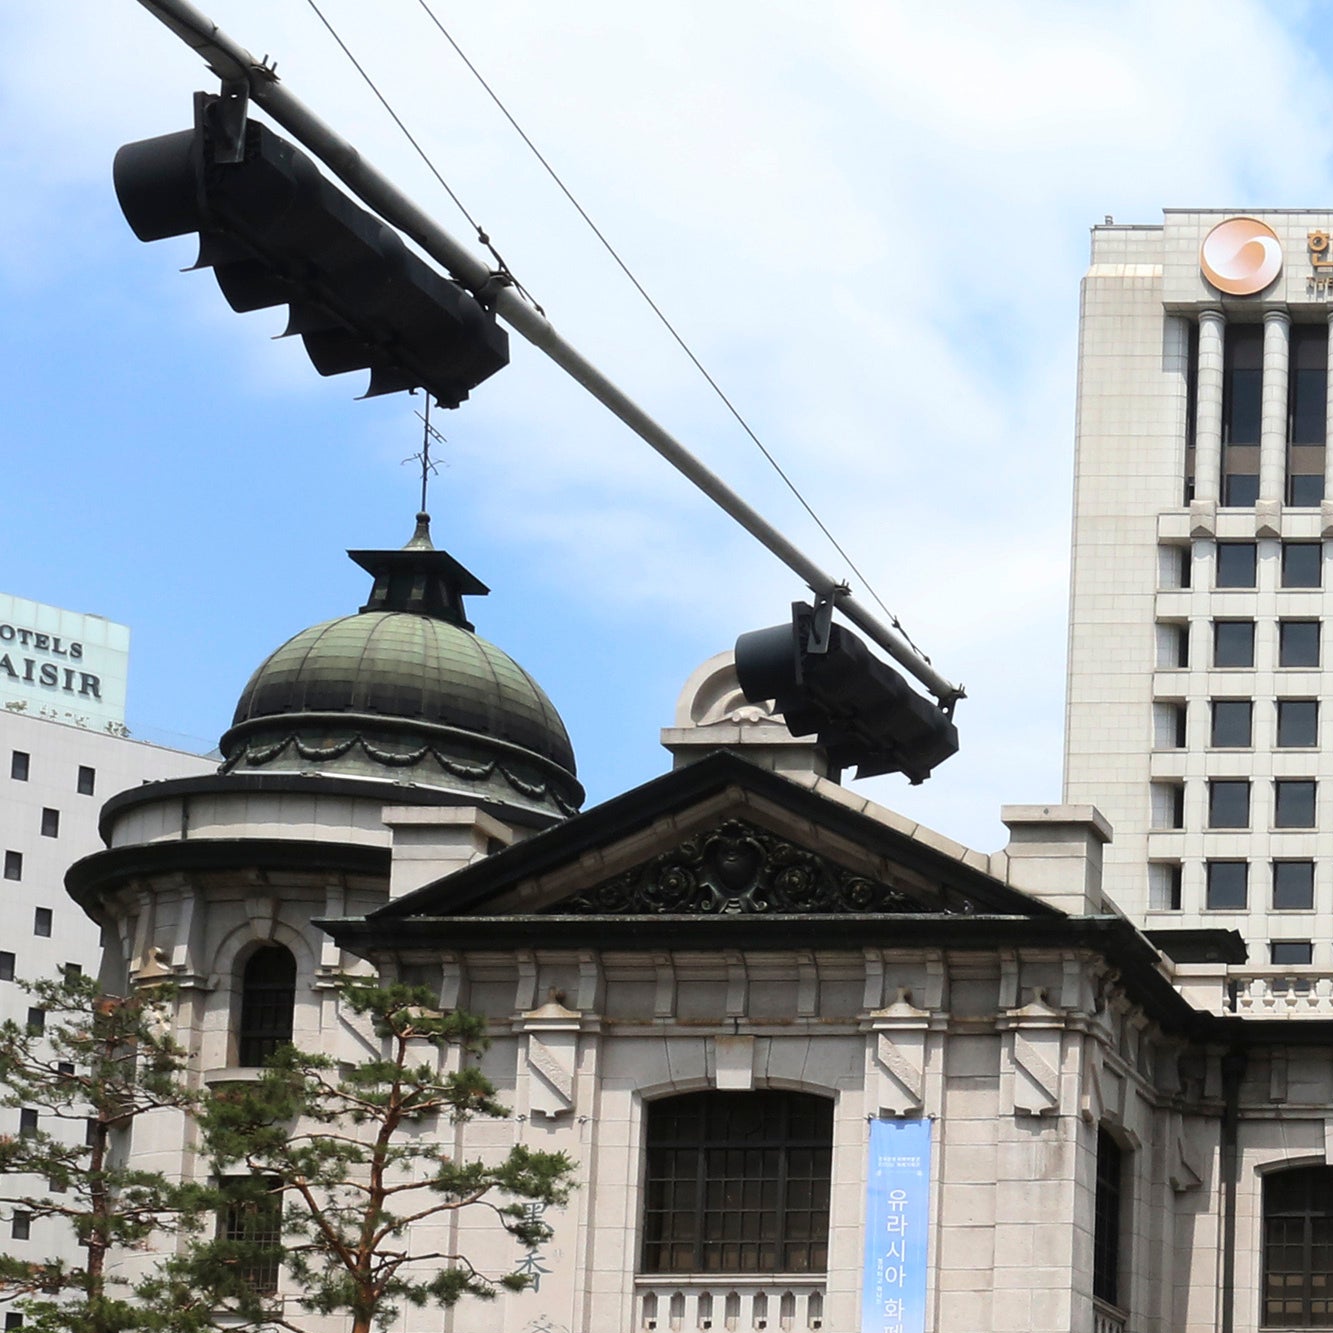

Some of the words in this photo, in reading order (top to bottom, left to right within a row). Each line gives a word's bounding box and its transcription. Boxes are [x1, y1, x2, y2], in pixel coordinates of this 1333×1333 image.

[1306, 277, 1333, 288] THE
[0, 624, 83, 659] OTELS
[885, 1189, 909, 1288] 유라시아
